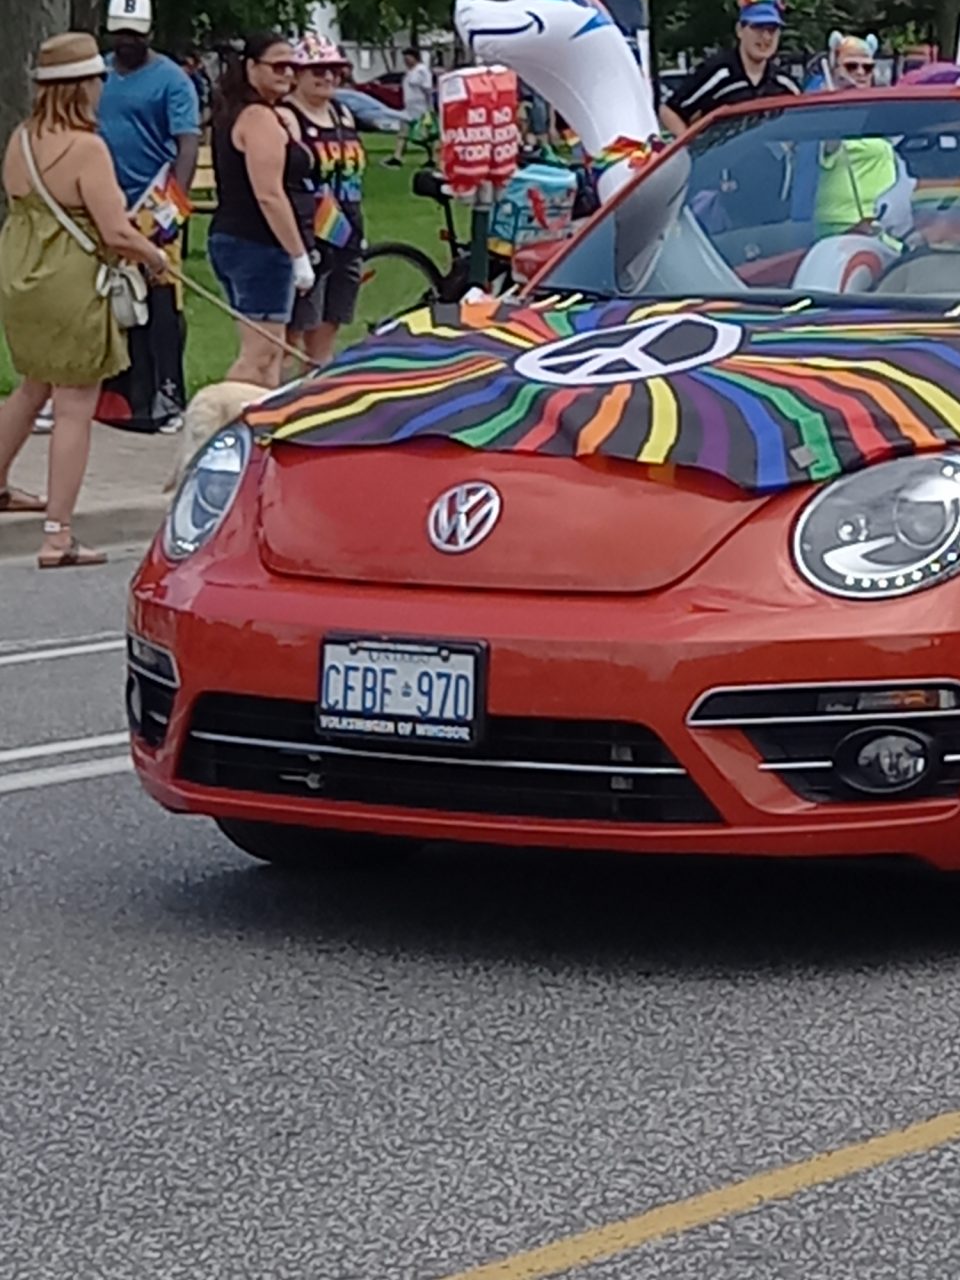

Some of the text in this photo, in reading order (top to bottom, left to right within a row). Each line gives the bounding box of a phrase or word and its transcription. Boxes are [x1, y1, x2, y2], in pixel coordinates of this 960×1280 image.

[467, 107, 487, 125] NO
[492, 106, 512, 125] NO
[428, 480, 501, 552] VW
[416, 671, 470, 721] 970
